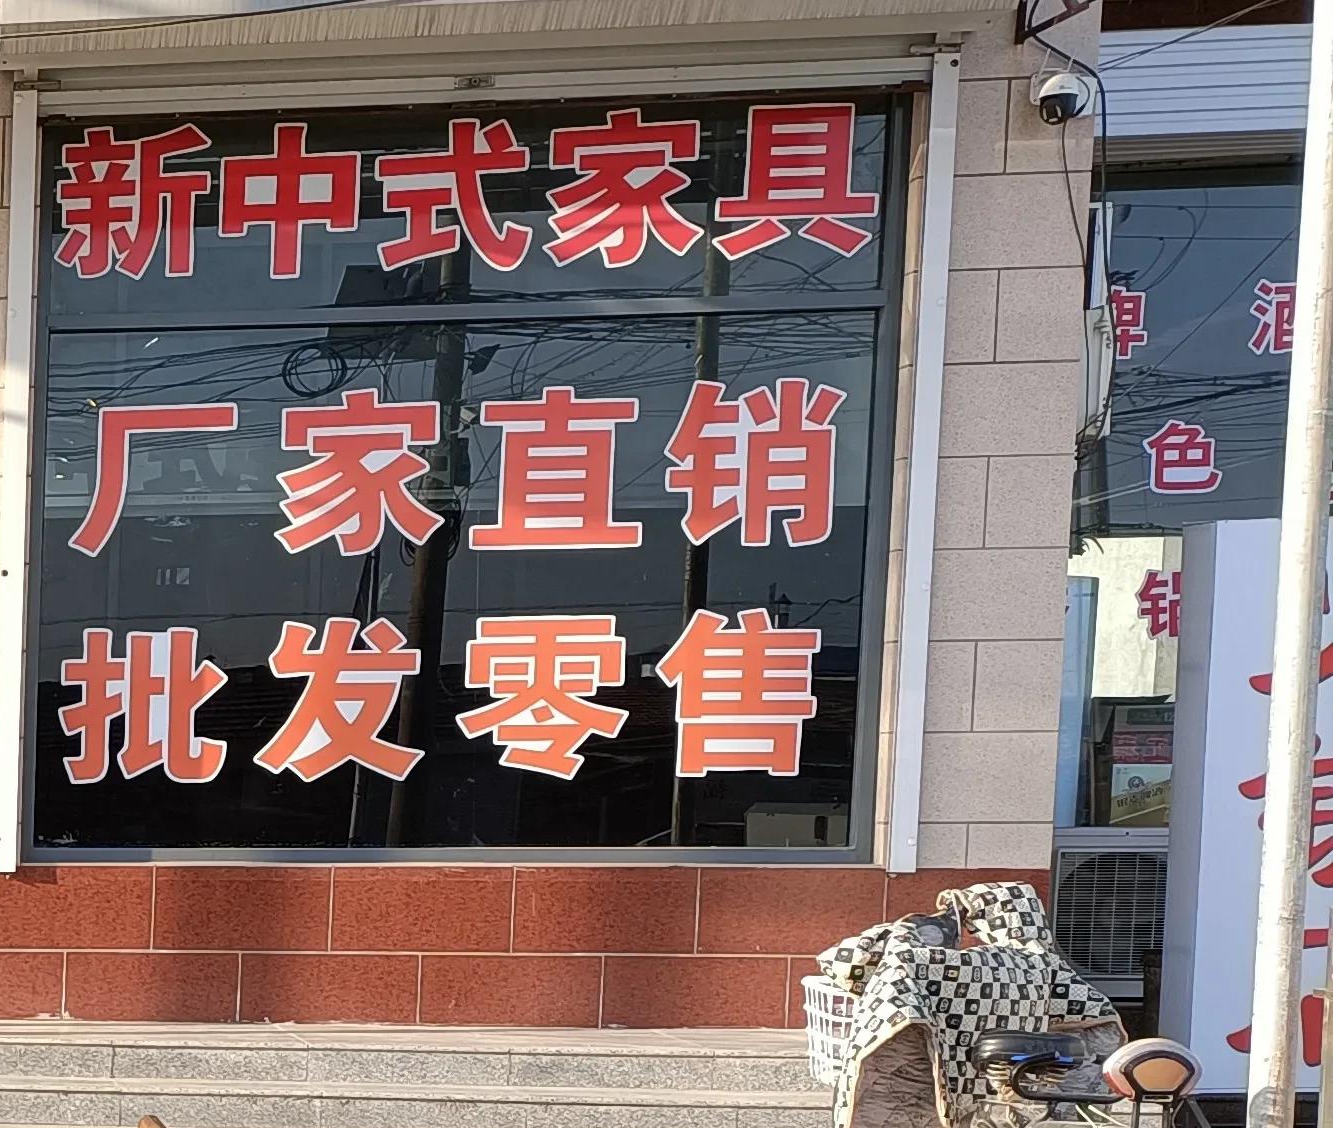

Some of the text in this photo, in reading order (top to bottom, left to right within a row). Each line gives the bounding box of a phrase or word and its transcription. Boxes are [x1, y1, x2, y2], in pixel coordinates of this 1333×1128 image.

[55, 103, 880, 280] 新中式家具
[68, 377, 847, 558] 厂家直销
[1142, 418, 1223, 494] 色
[60, 608, 822, 786] 批发零售
